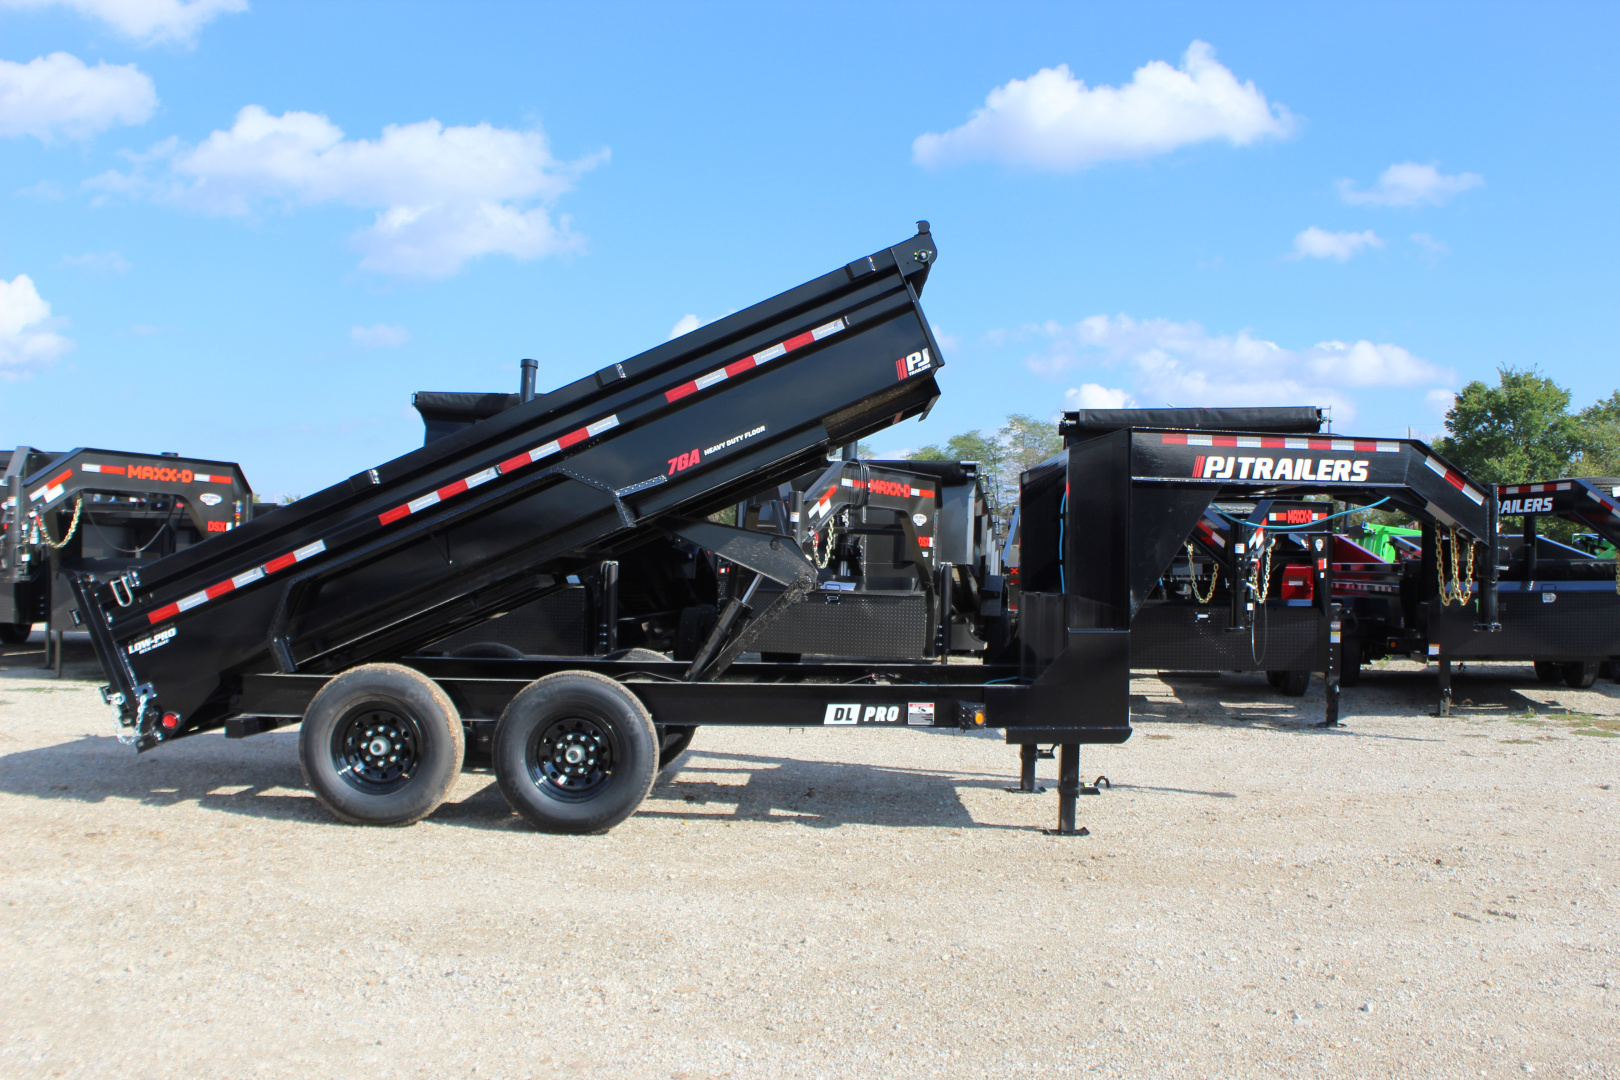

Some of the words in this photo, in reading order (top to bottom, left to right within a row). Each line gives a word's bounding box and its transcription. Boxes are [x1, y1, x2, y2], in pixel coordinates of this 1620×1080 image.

[906, 347, 930, 372] PJ
[704, 441, 726, 456] HEAVY
[726, 434, 744, 447] DUTY
[744, 425, 766, 439] FLOOR
[127, 464, 193, 483] MAXX-D
[667, 448, 701, 475] 7GA
[1237, 456, 1369, 482] TRAILERS
[870, 478, 911, 498] MAXX-D
[207, 520, 226, 532] DSX
[128, 627, 177, 655] LOW-PRO
[833, 707, 853, 722] DL
[863, 706, 900, 722] PRO
